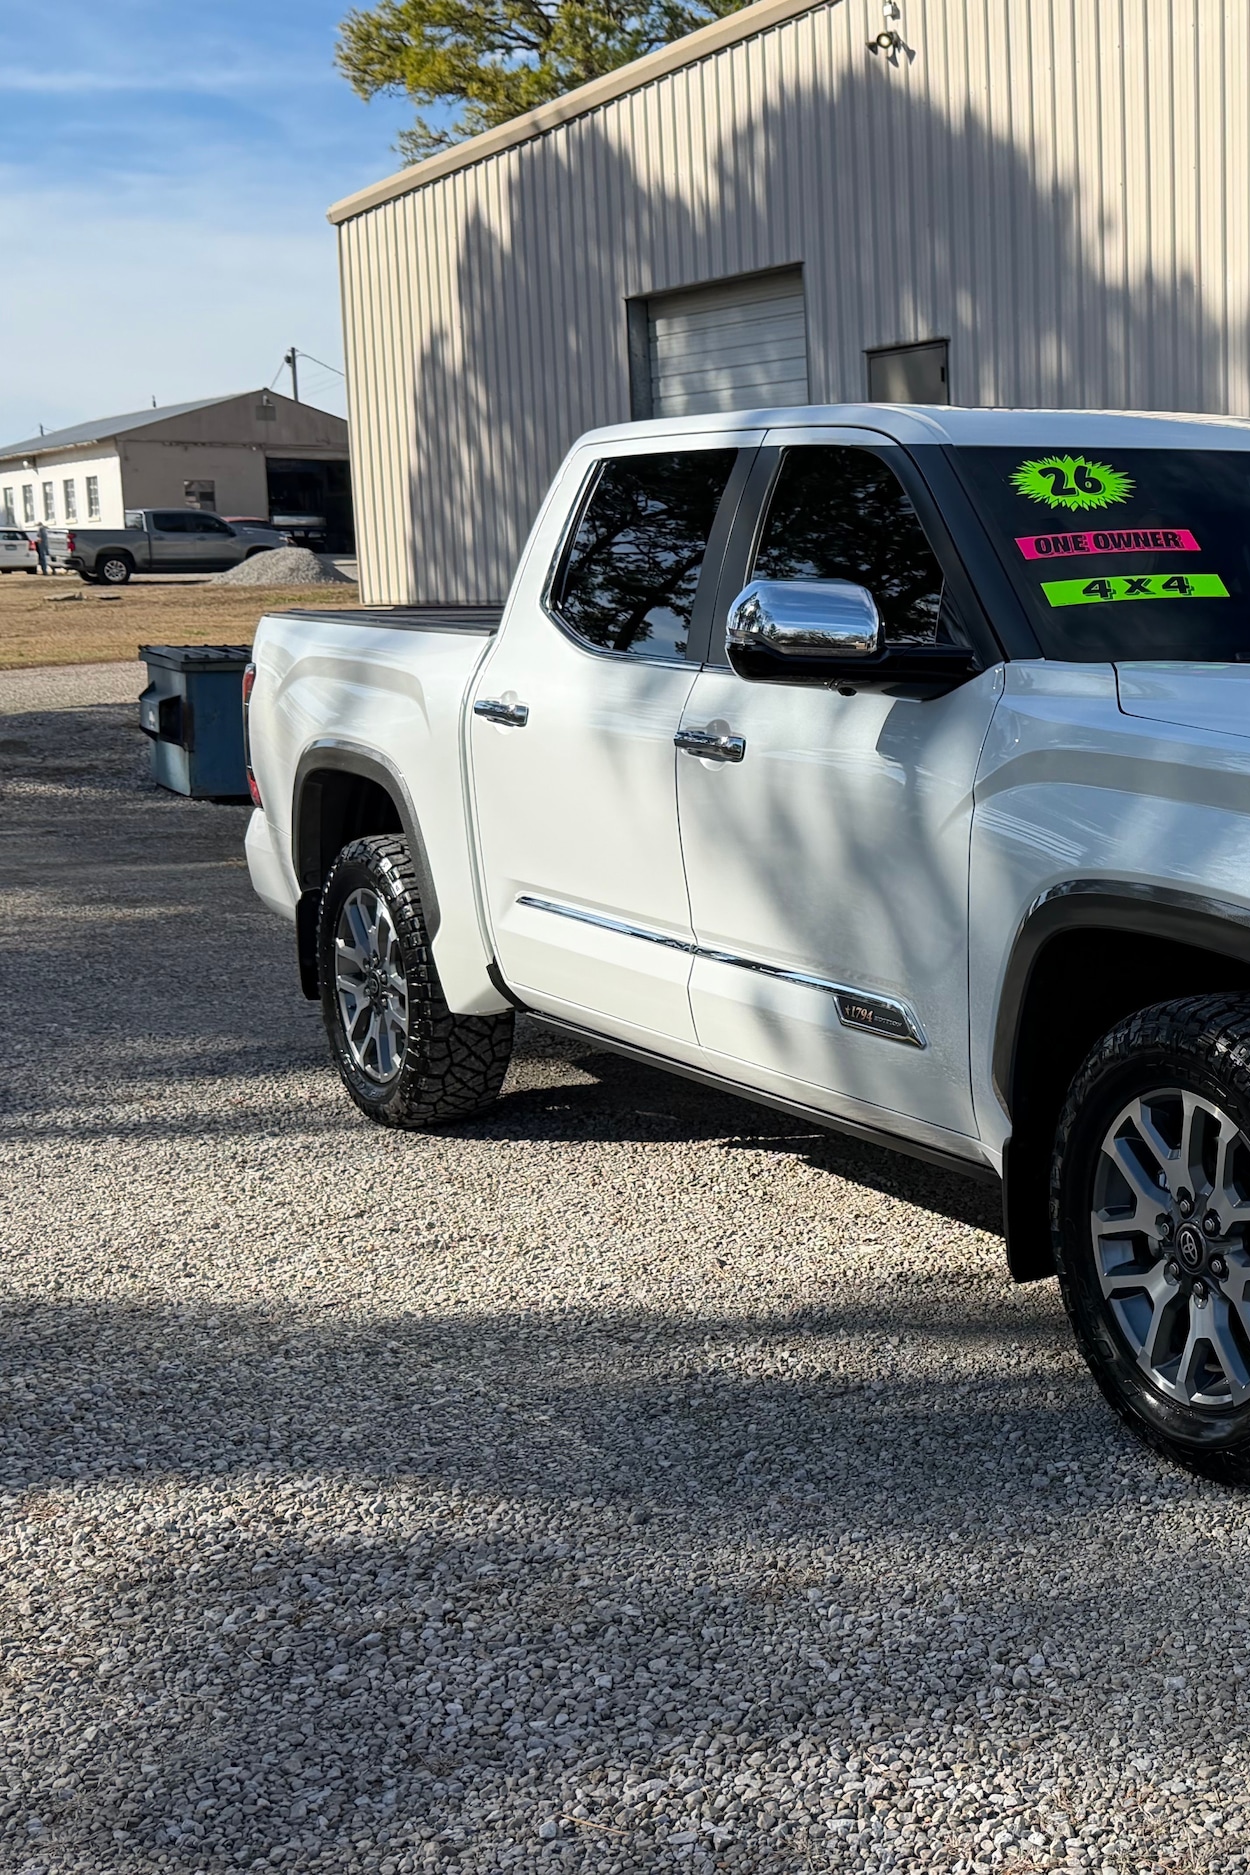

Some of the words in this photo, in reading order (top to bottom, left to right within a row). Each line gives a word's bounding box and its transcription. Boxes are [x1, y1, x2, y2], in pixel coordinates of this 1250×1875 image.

[1038, 465, 1107, 497] 26
[1034, 534, 1088, 556] ONE
[1092, 531, 1184, 552] OWNER
[851, 1006, 874, 1023] 1794
